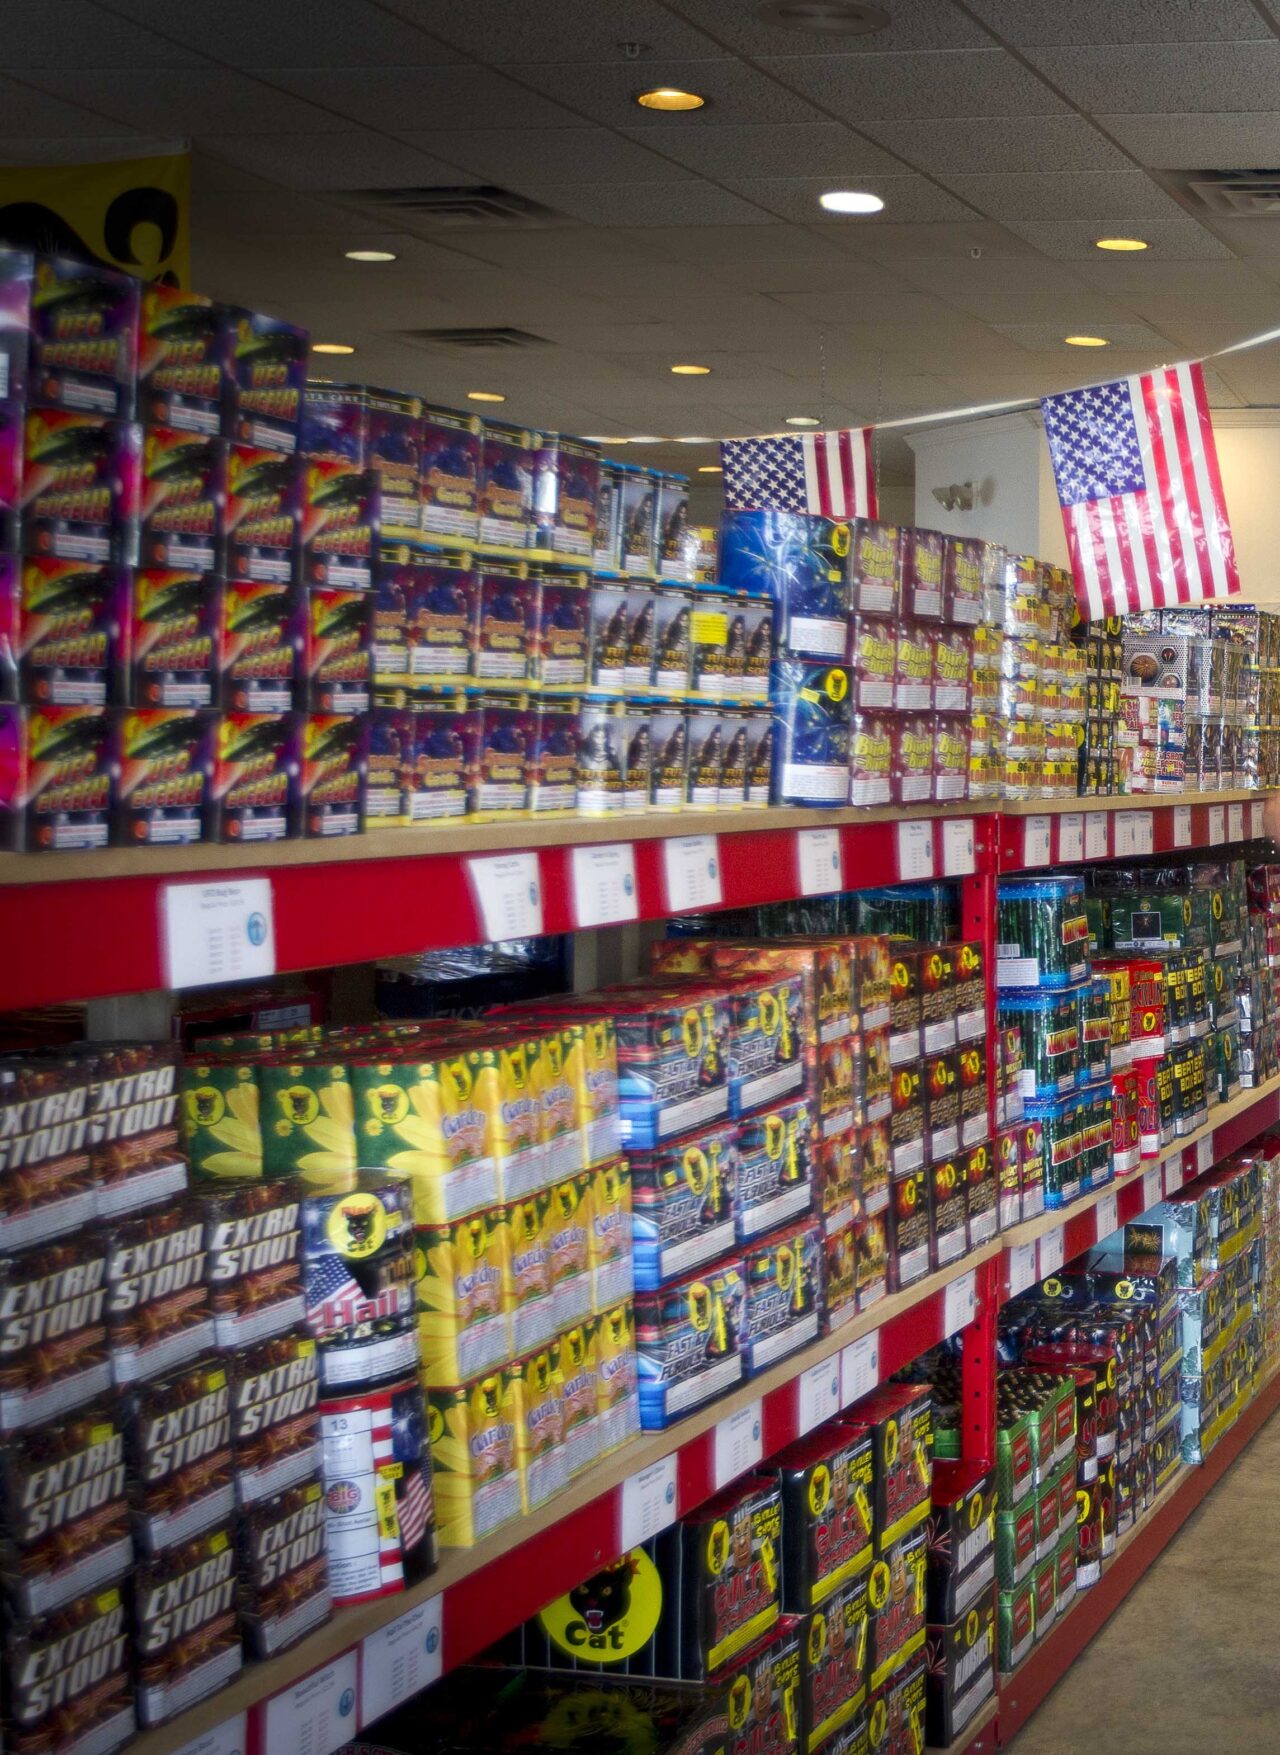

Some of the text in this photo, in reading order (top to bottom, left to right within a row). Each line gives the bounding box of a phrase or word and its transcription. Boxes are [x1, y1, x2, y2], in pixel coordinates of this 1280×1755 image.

[0, 1087, 87, 1141] XTRA
[109, 1223, 204, 1281] EXTRA
[210, 1203, 300, 1252] EXTRA
[211, 1230, 301, 1280] STOUT
[347, 1238, 375, 1253] Cat
[552, 1221, 590, 1252] arden
[0, 1258, 105, 1321] EXTRA
[110, 1252, 207, 1312] STOUT
[323, 1288, 398, 1330] Hail
[0, 1288, 108, 1352] STOUT
[235, 1352, 317, 1409] EXTRA
[238, 1378, 319, 1437] STOUT
[147, 1386, 230, 1451] EXTRA
[148, 1412, 231, 1481] STOUT
[331, 1418, 348, 1431] 13
[22, 1433, 124, 1508] EXTRA
[24, 1462, 126, 1540] STOUT
[260, 1519, 326, 1588] STOU
[144, 1548, 234, 1622] EXTRA
[146, 1575, 238, 1651] STOUT
[20, 1603, 124, 1688] EXTRA
[564, 1620, 625, 1650] Cat
[22, 1632, 129, 1721] STOUT
